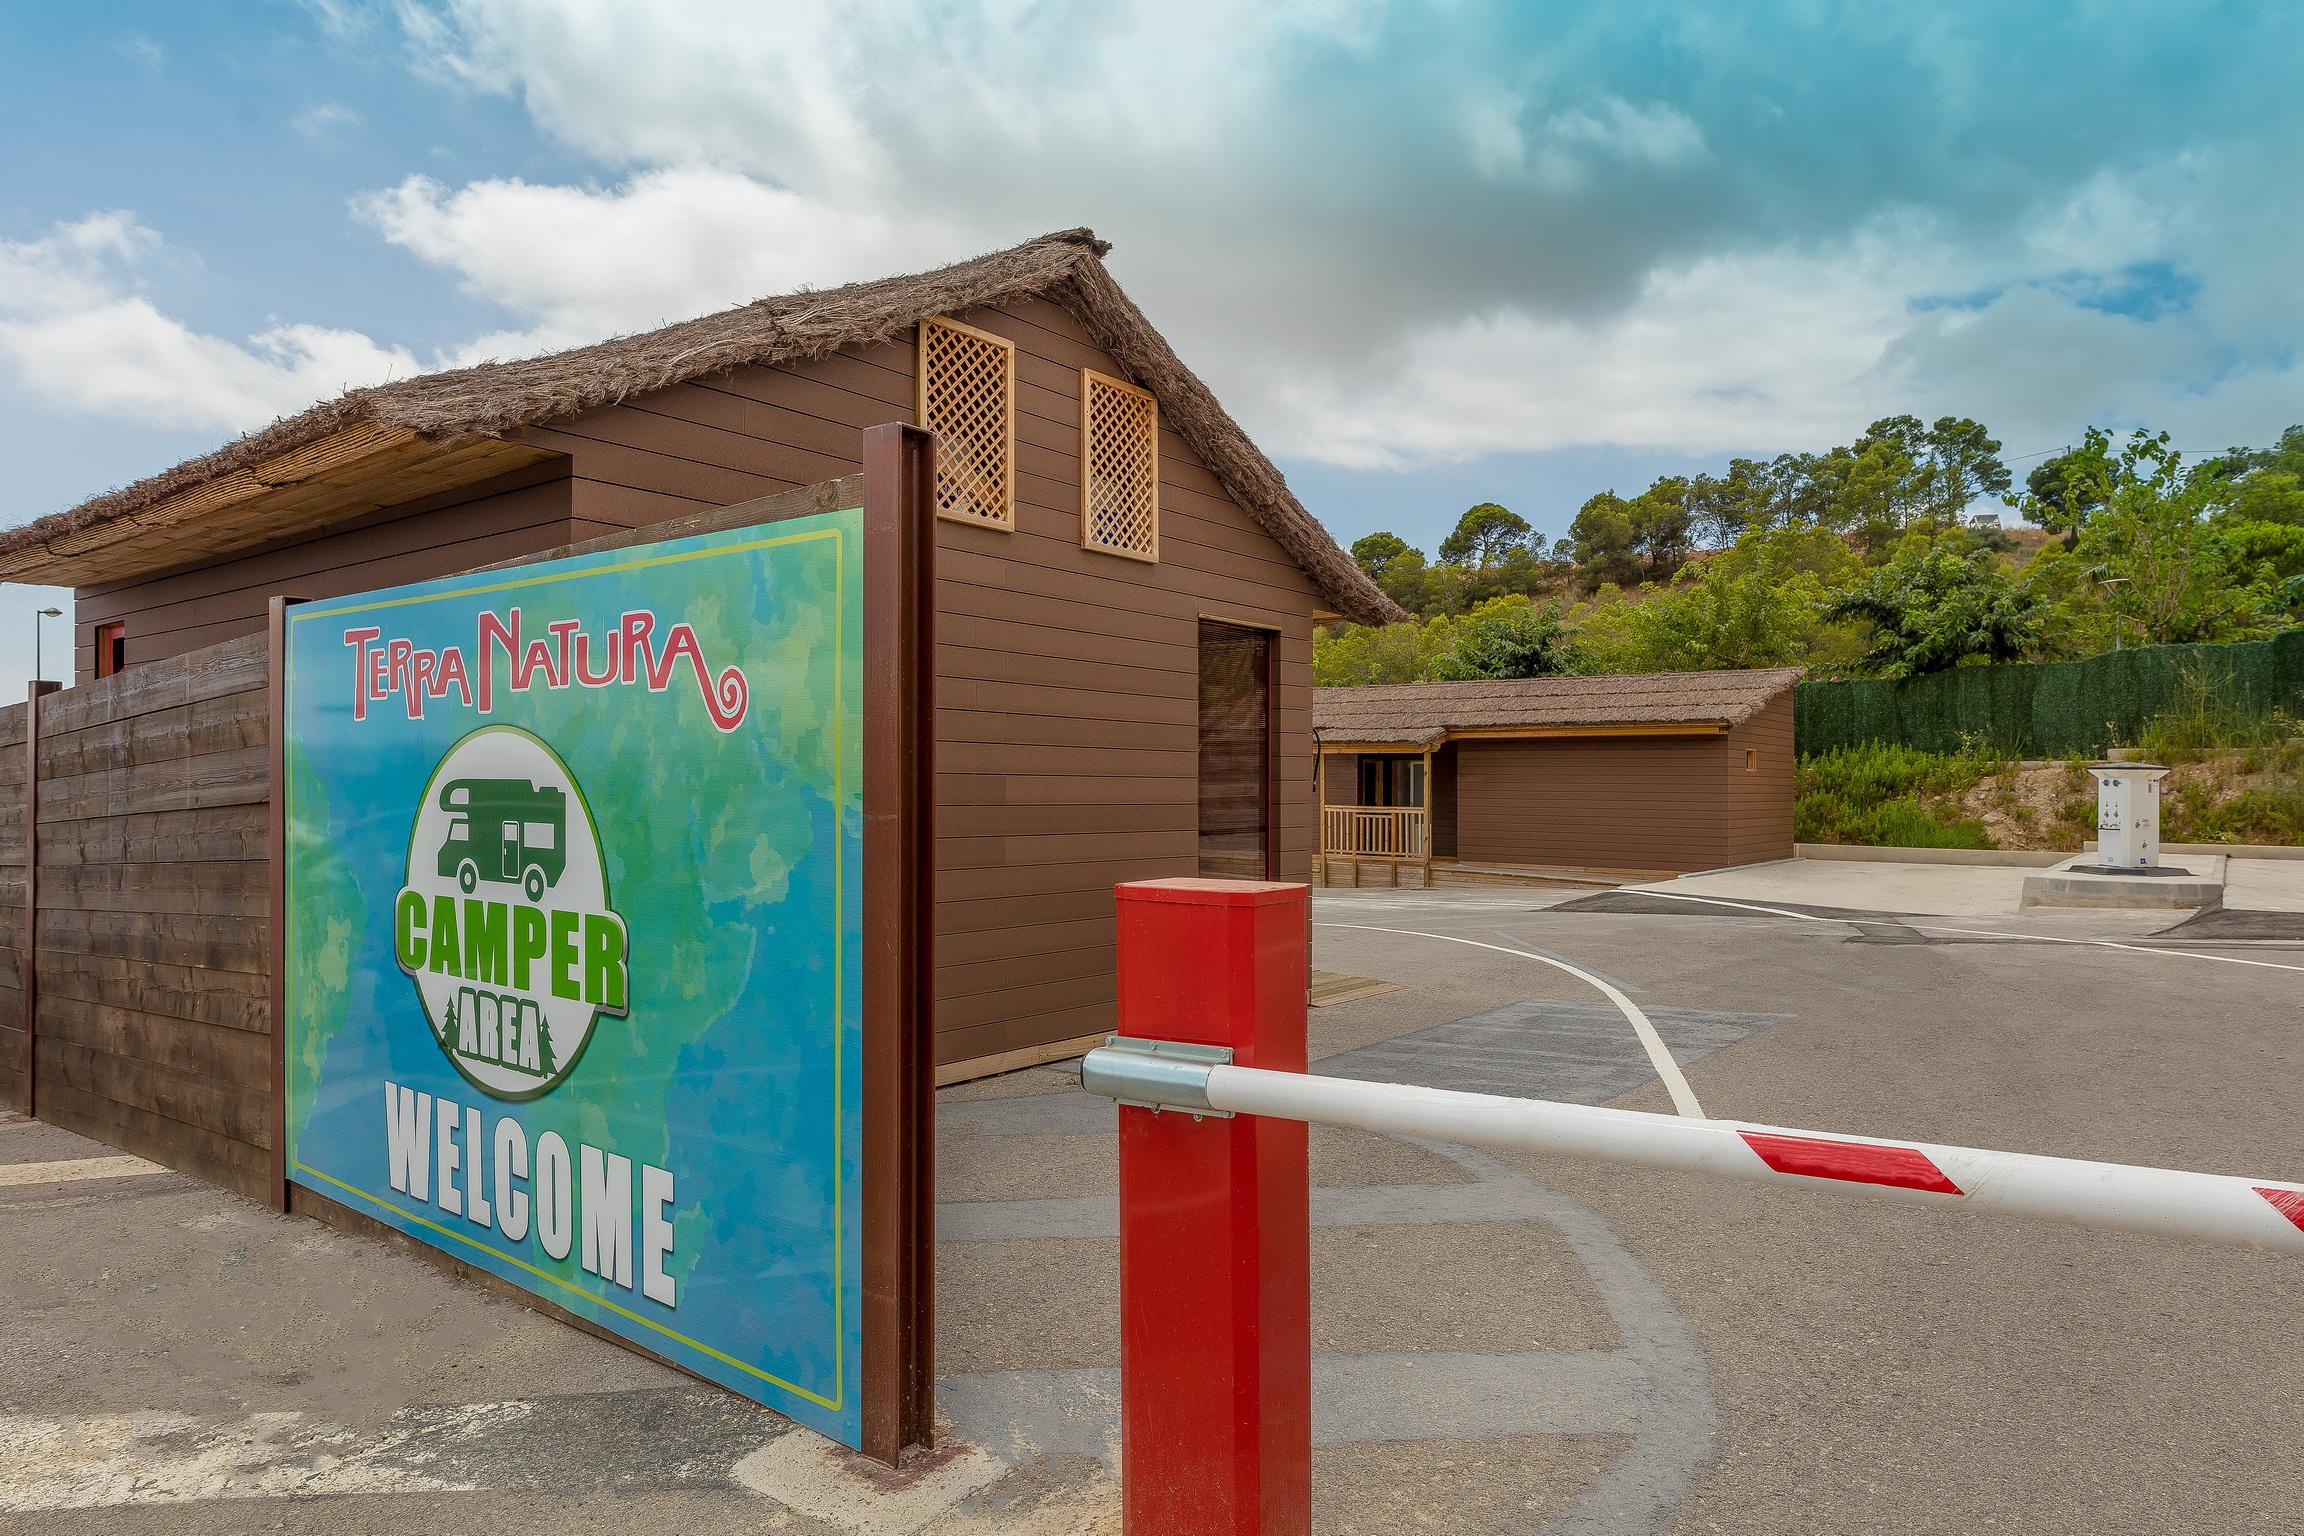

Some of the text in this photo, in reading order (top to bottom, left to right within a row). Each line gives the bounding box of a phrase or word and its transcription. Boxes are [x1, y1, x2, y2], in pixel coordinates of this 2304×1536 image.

[345, 608, 748, 732] TERRA NATURA
[397, 890, 625, 1007] CAMPER
[458, 992, 541, 1071] AREA
[384, 1081, 676, 1308] WELCOME
